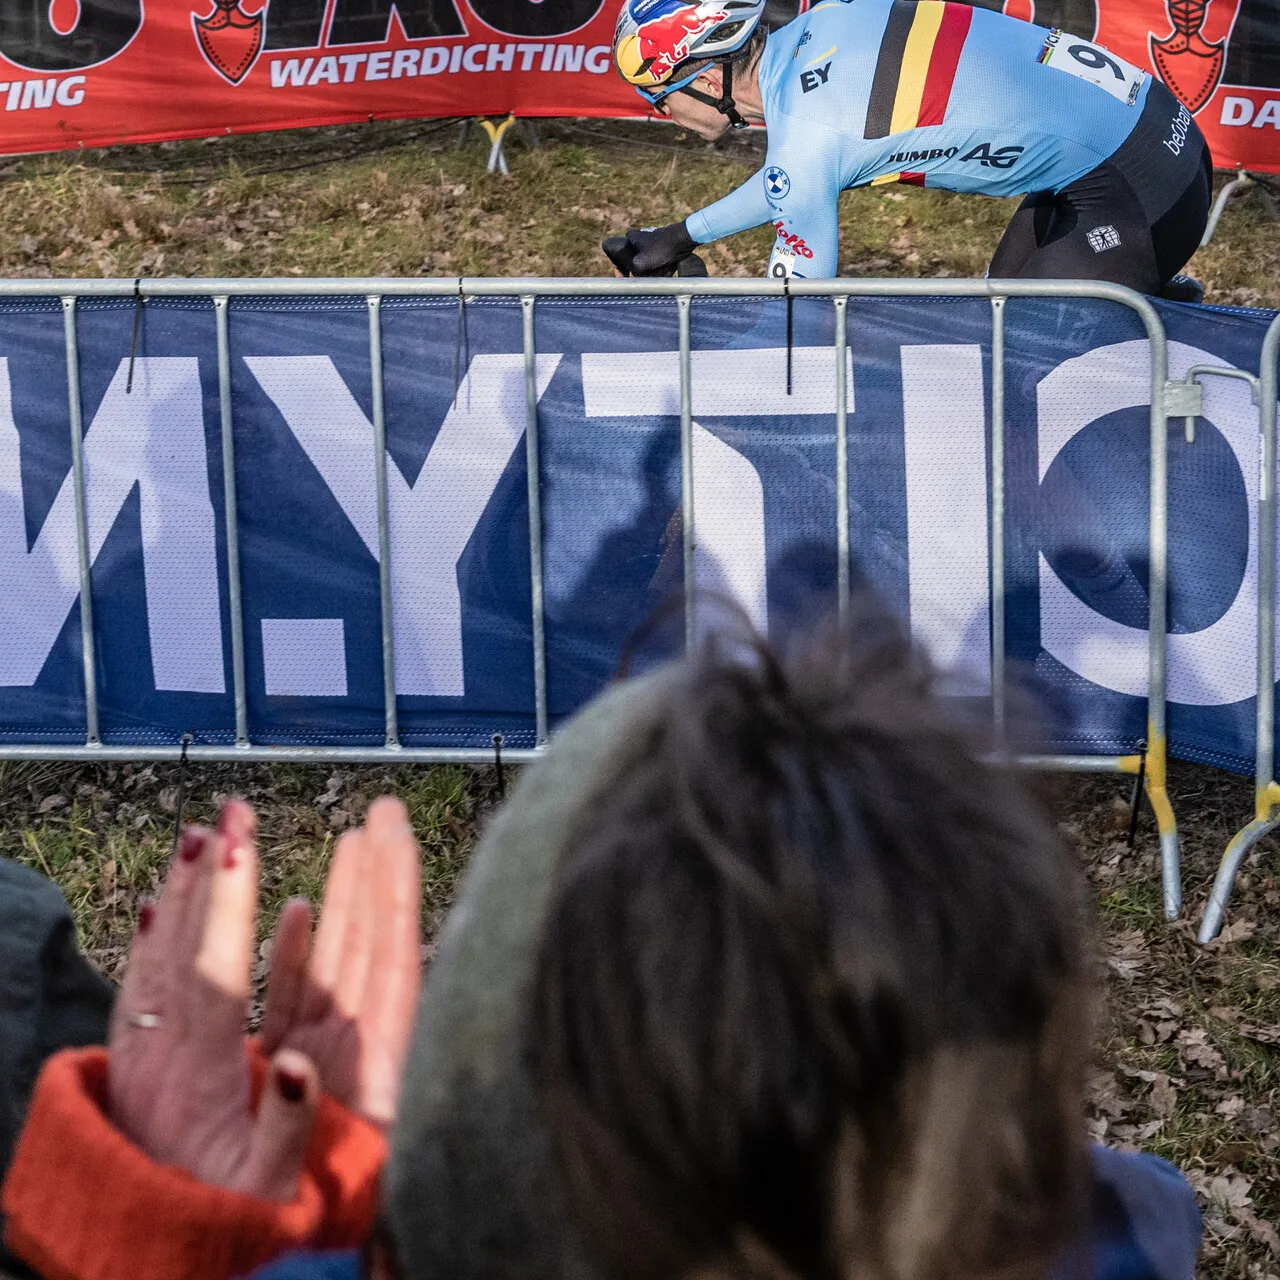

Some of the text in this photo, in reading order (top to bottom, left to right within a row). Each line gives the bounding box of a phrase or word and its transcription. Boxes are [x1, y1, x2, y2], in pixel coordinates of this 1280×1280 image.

[271, 43, 613, 89] WATERDICHTING
[800, 60, 833, 94] EY
[1067, 44, 1126, 82] 9
[886, 142, 1025, 169] JUMBO AG
